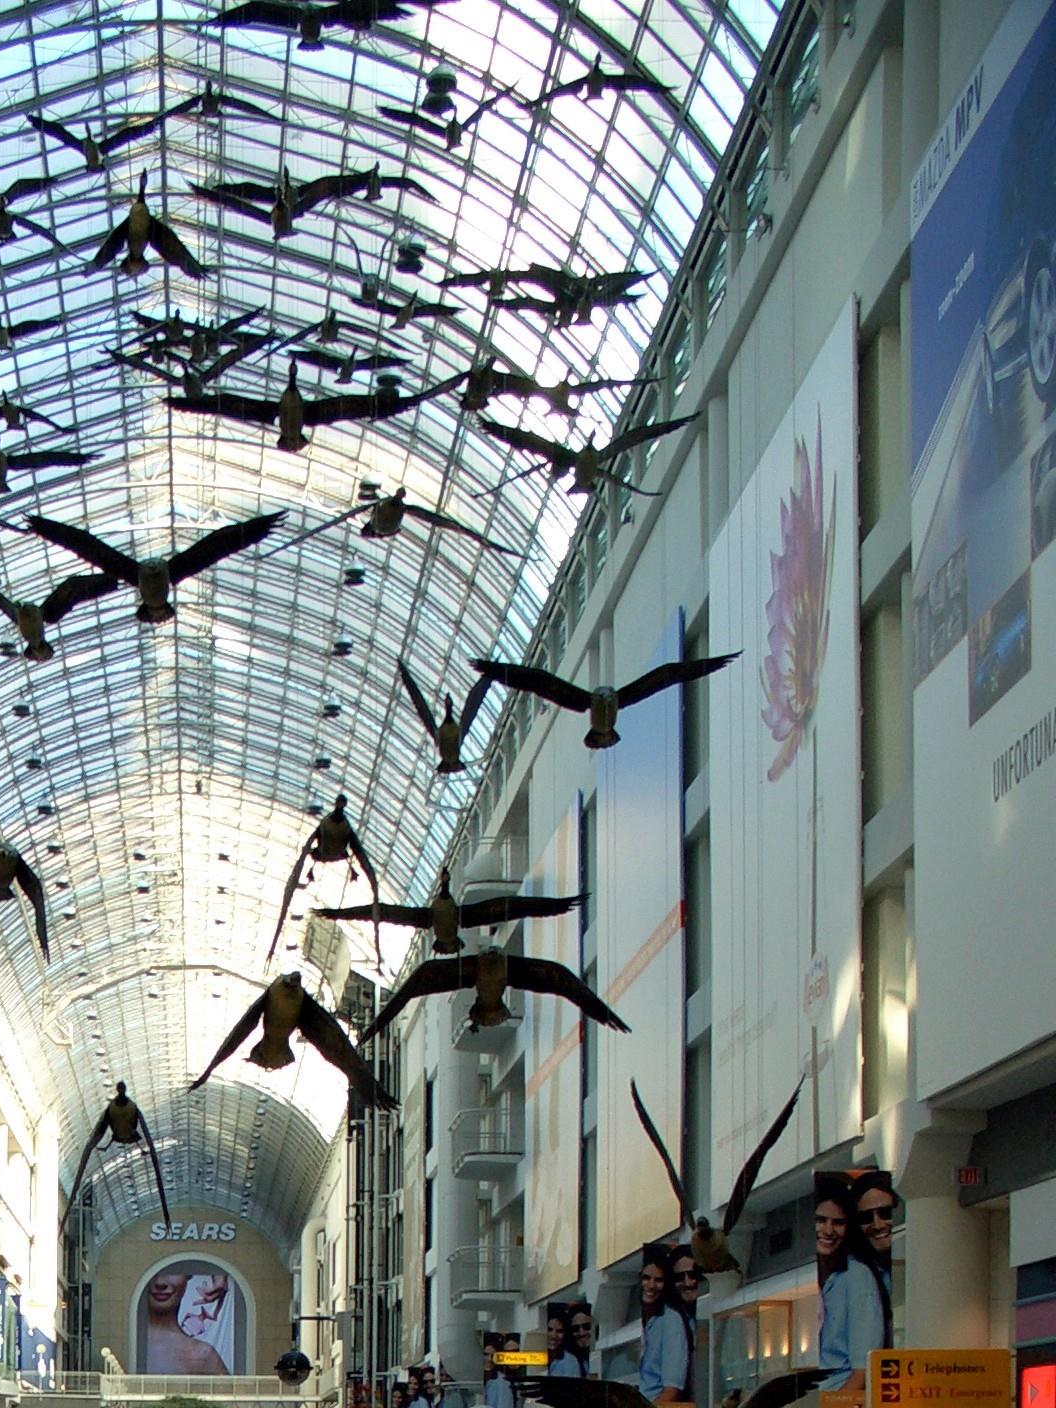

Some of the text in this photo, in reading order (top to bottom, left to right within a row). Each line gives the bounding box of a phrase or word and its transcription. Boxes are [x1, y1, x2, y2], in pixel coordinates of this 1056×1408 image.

[955, 64, 984, 152] MPV
[149, 1222, 237, 1241] SEARS
[925, 1361, 986, 1376] Telephones
[909, 1387, 1003, 1400] EXIT Emergency
